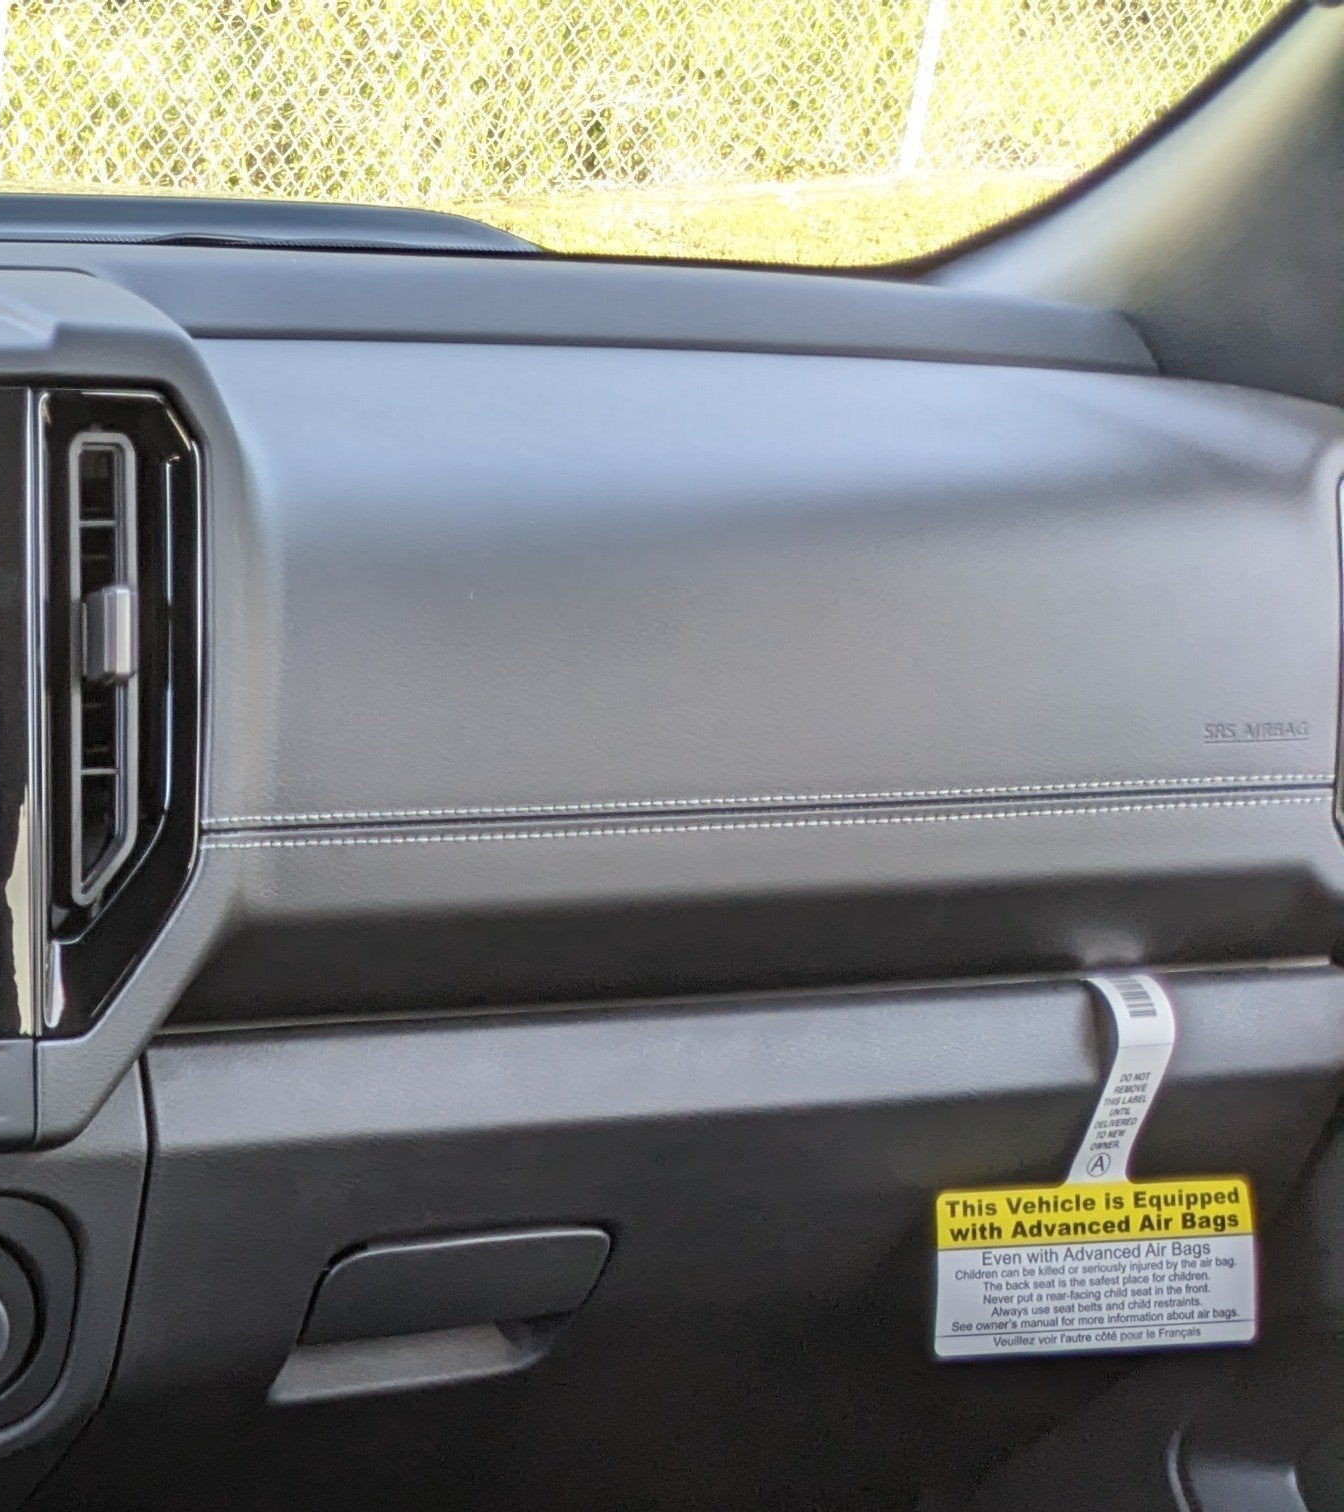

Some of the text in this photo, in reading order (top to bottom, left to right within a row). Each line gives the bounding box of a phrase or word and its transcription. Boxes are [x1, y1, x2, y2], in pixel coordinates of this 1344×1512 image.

[1204, 721, 1311, 738] SRS AIRBAG
[946, 1188, 1239, 1217] This Vehicle is Equipped
[950, 1212, 1239, 1241] with Advanced Air Bags
[982, 1242, 1210, 1266] Even with Advanced Air Bags
[991, 1297, 1202, 1318] Always use seat belts and child restraints.
[952, 1308, 1239, 1332] See owner's manual for more information about air bags.
